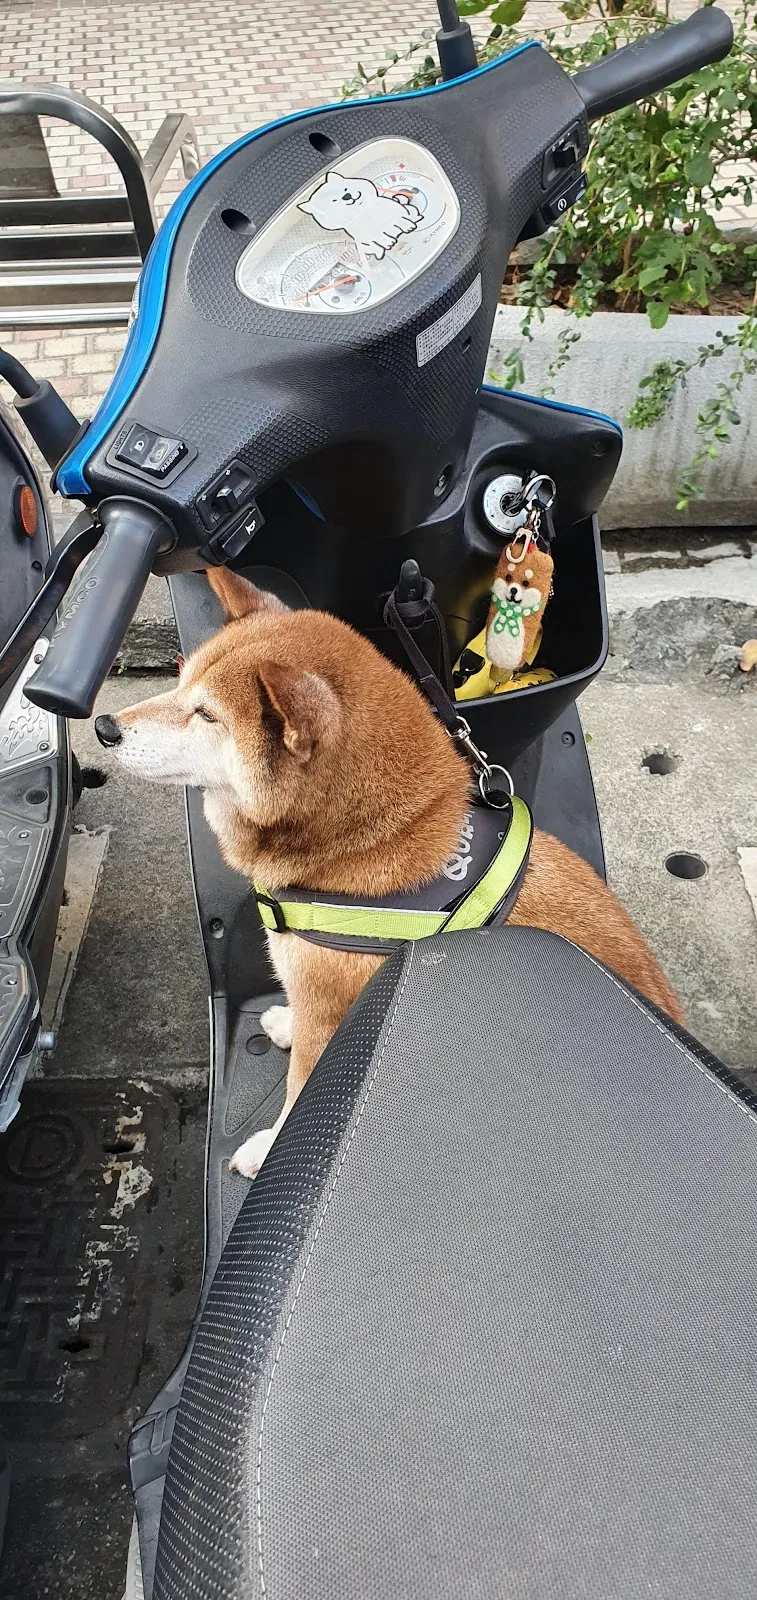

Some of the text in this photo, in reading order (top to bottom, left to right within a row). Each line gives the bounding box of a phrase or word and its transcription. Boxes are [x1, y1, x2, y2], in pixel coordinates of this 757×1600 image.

[352, 291, 367, 305] km/h
[112, 429, 128, 451] LIGHTS
[160, 449, 180, 473] PASSING
